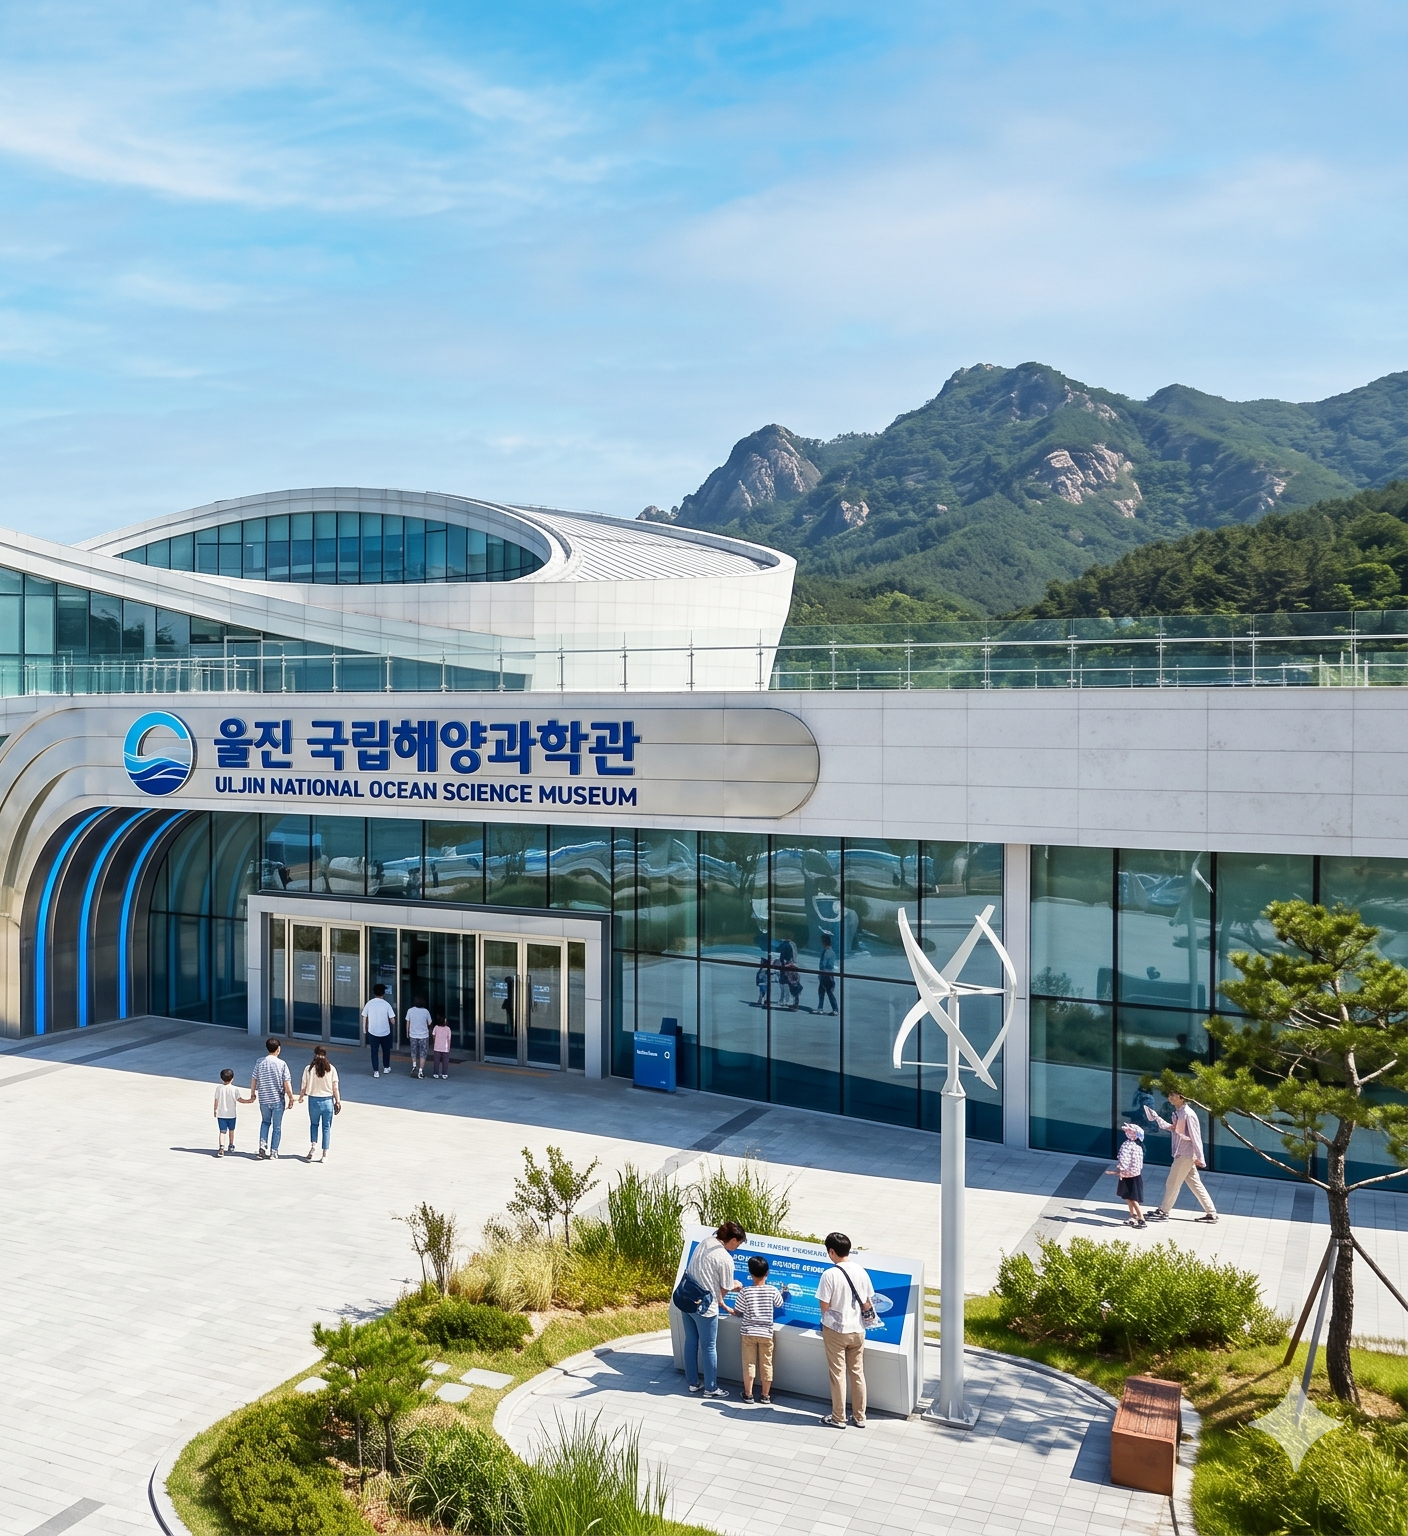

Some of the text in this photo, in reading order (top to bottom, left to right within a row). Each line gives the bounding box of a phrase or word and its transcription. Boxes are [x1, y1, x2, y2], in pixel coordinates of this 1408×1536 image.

[213, 717, 641, 777] 울진 국립해양과학관
[215, 776, 638, 806] ULJIN NATIONAL OCEAN SCIENCE MUSEUM
